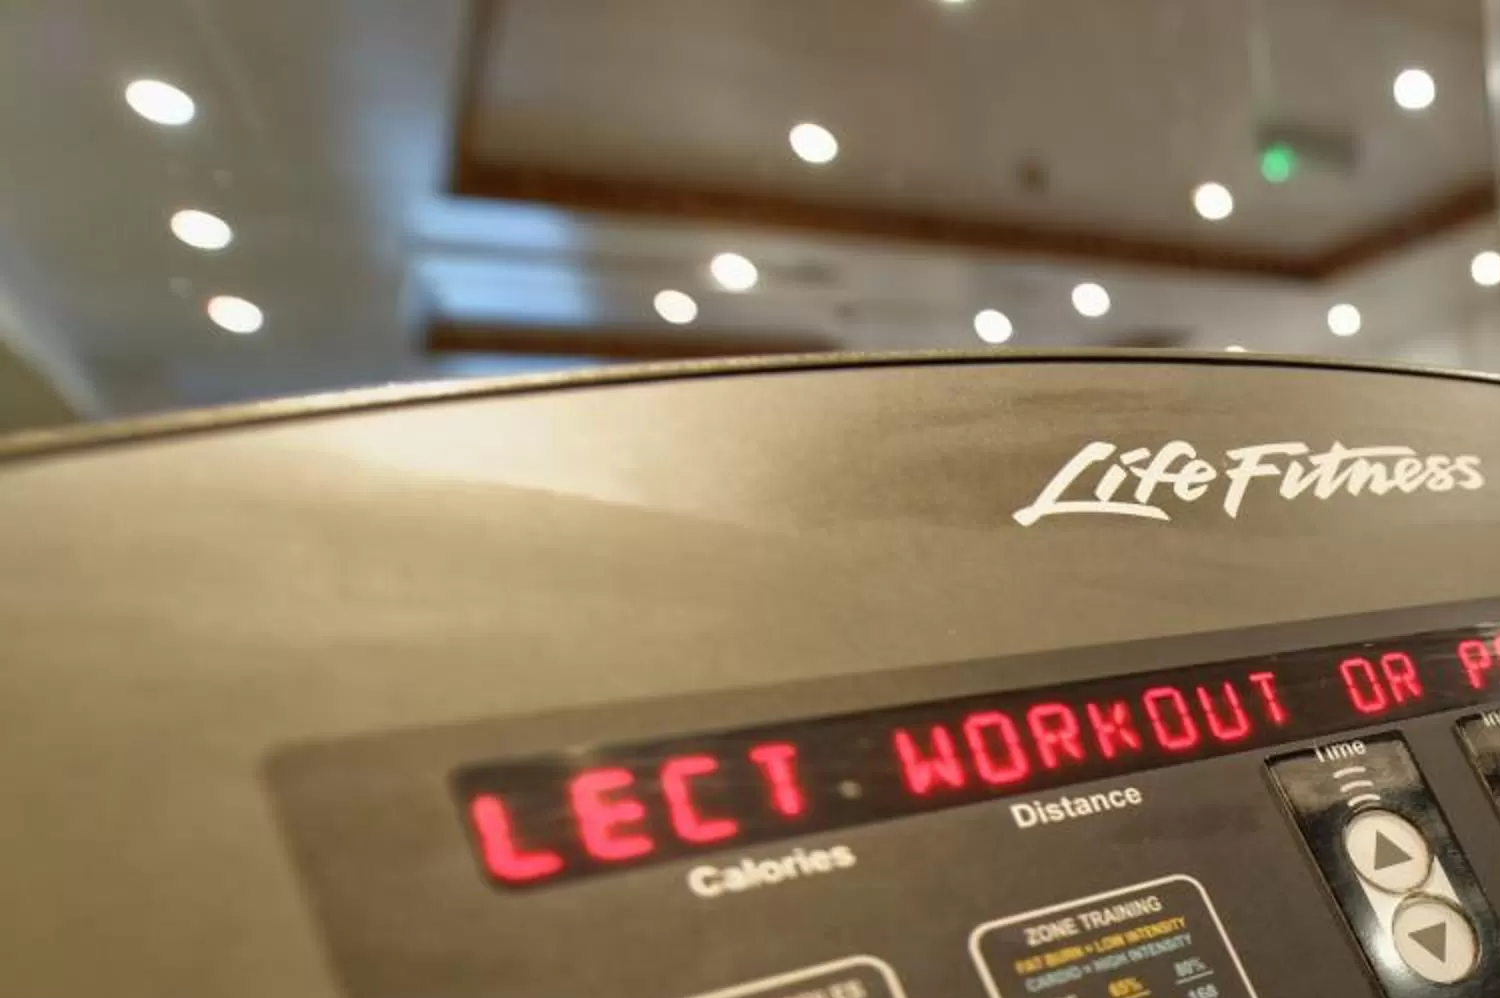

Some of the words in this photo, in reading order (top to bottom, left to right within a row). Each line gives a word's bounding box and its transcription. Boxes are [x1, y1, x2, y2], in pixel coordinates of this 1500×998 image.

[1012, 441, 1218, 527] Life
[1223, 440, 1485, 519] Fitness
[471, 742, 806, 881] LECT
[894, 670, 1289, 796] WORKOUT
[1339, 651, 1422, 714] OR
[1314, 738, 1367, 763] Time
[1009, 785, 1143, 829] Distance
[687, 844, 857, 897] Calories
[1024, 918, 1079, 947] ZONE
[1078, 895, 1163, 930] TRAINING
